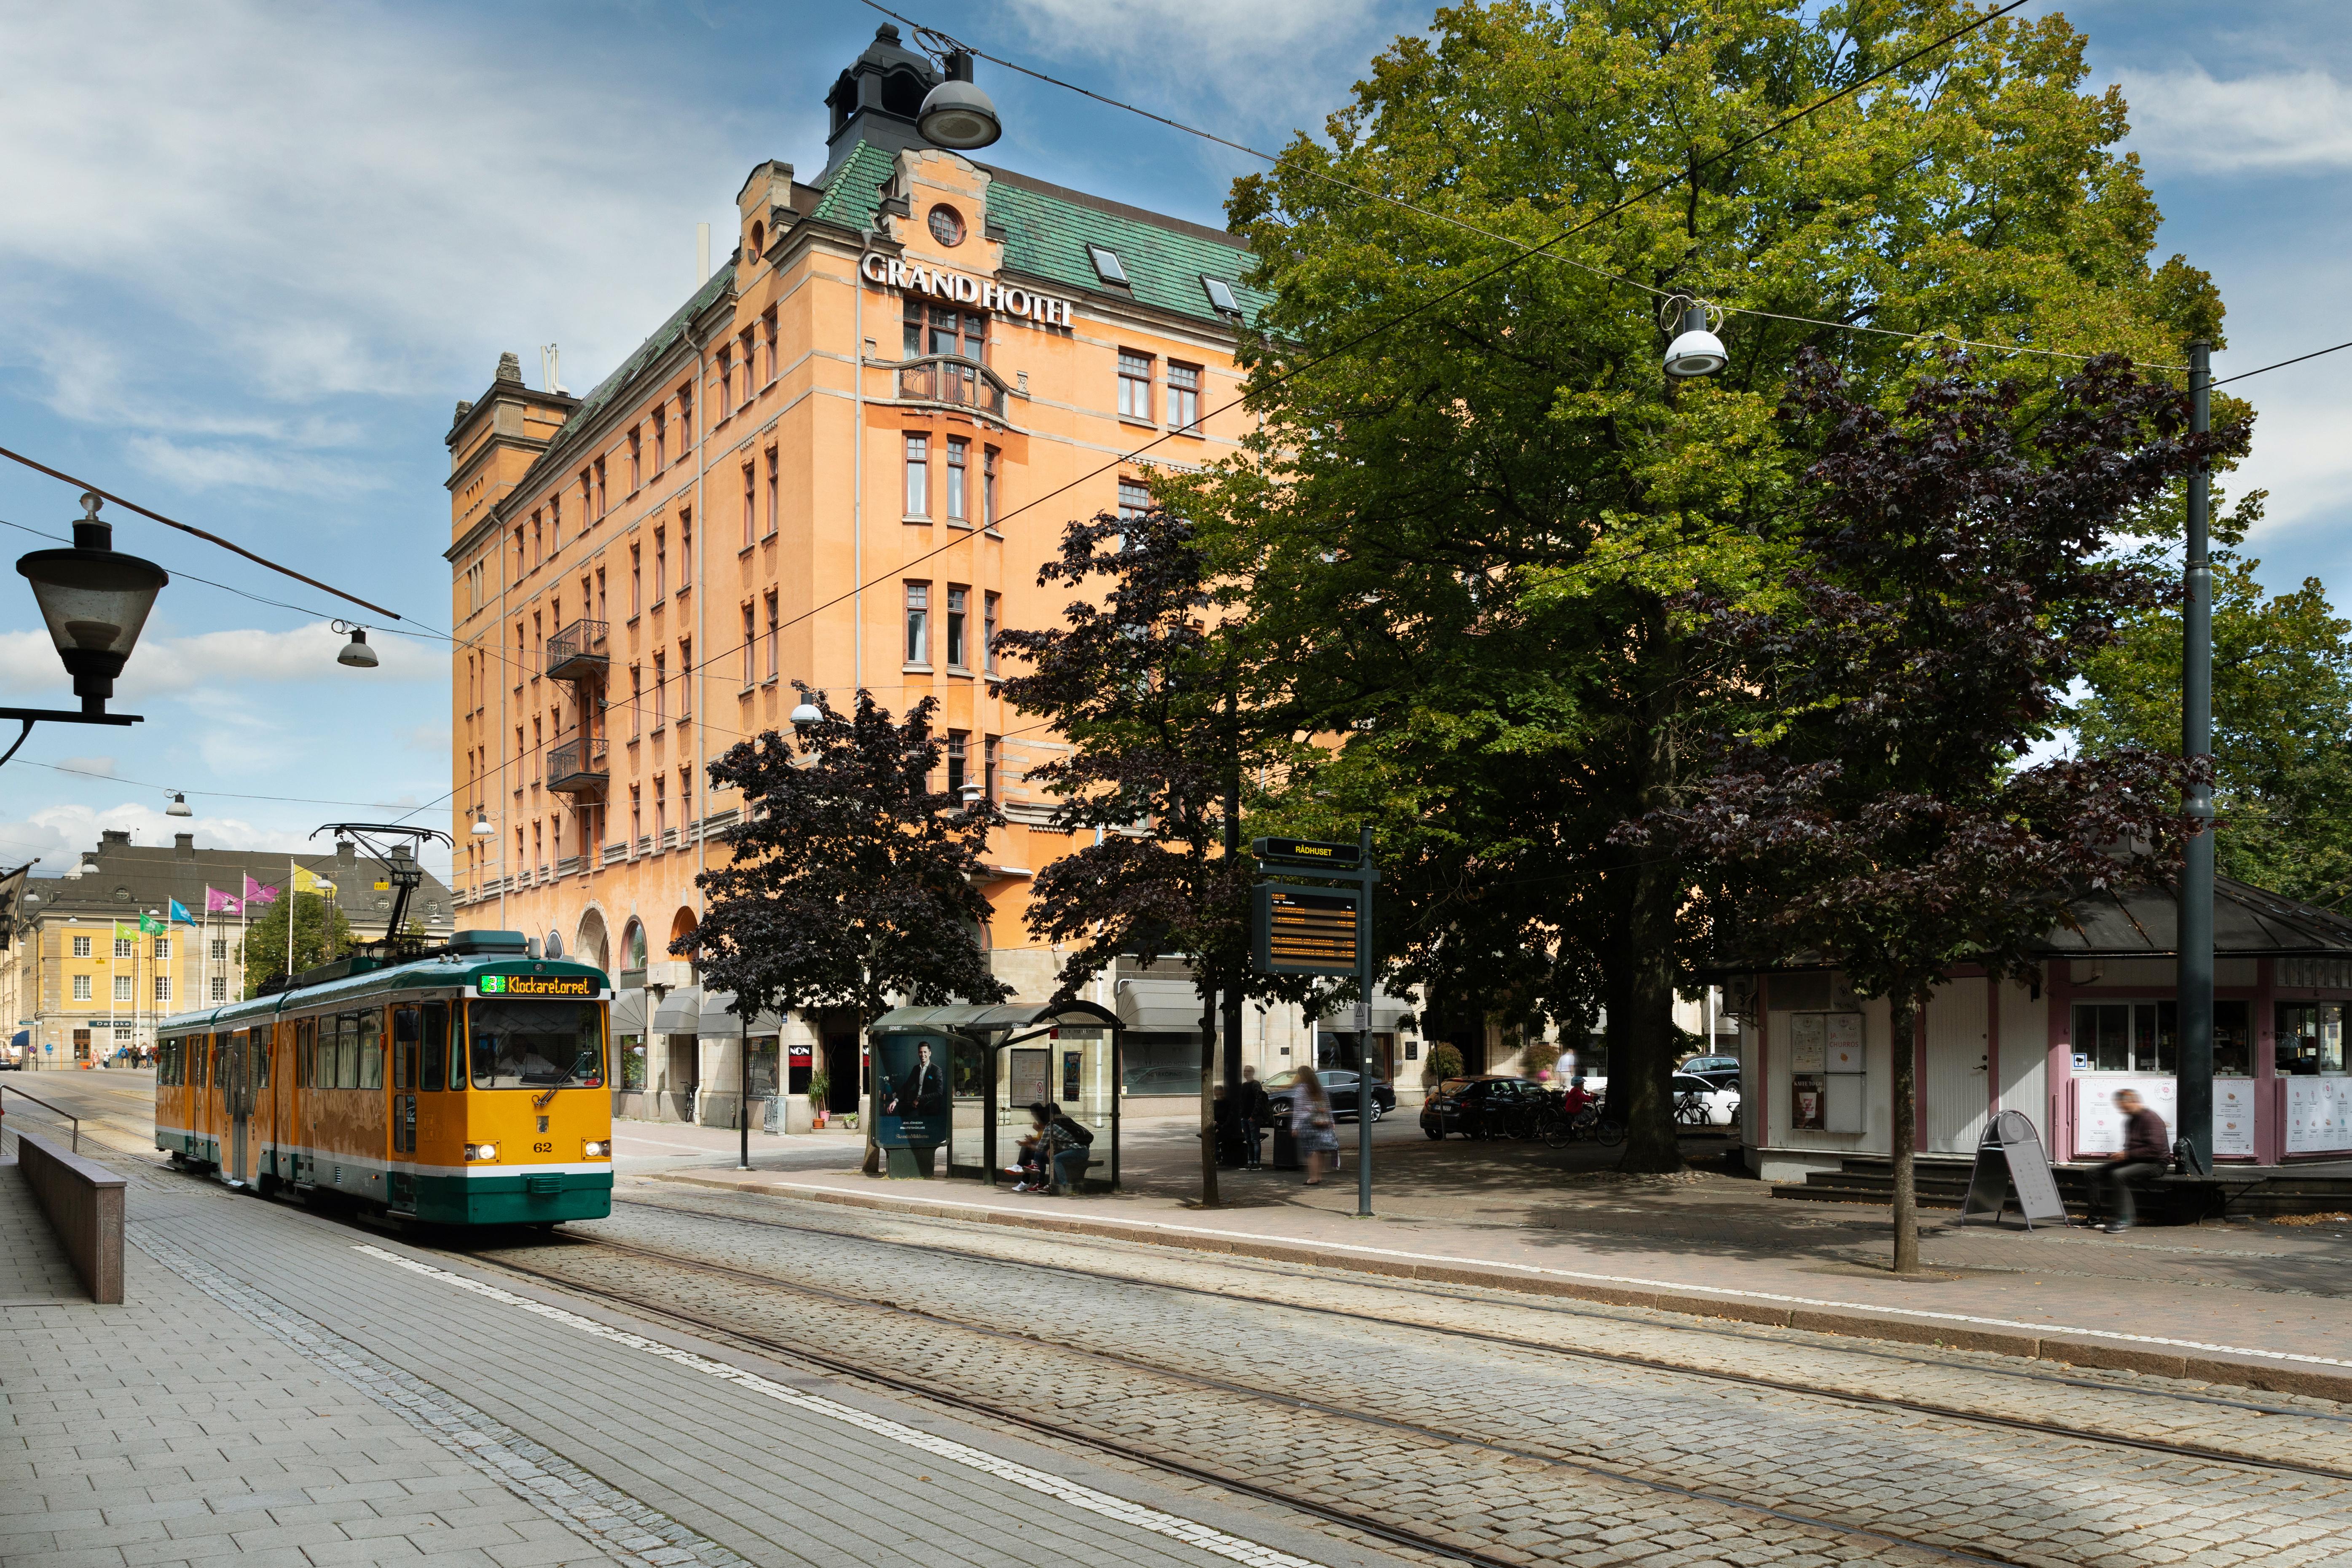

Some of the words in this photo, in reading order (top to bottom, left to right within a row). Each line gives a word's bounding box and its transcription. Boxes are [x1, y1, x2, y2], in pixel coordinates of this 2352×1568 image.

[861, 252, 979, 303] GRAND
[981, 280, 1076, 329] HOTEL
[1295, 844, 1332, 856] RÅDHUSET
[489, 976, 497, 993] 3
[509, 976, 590, 994] Klockaretorpet
[790, 1047, 809, 1055] NON
[533, 1142, 552, 1153] 62
